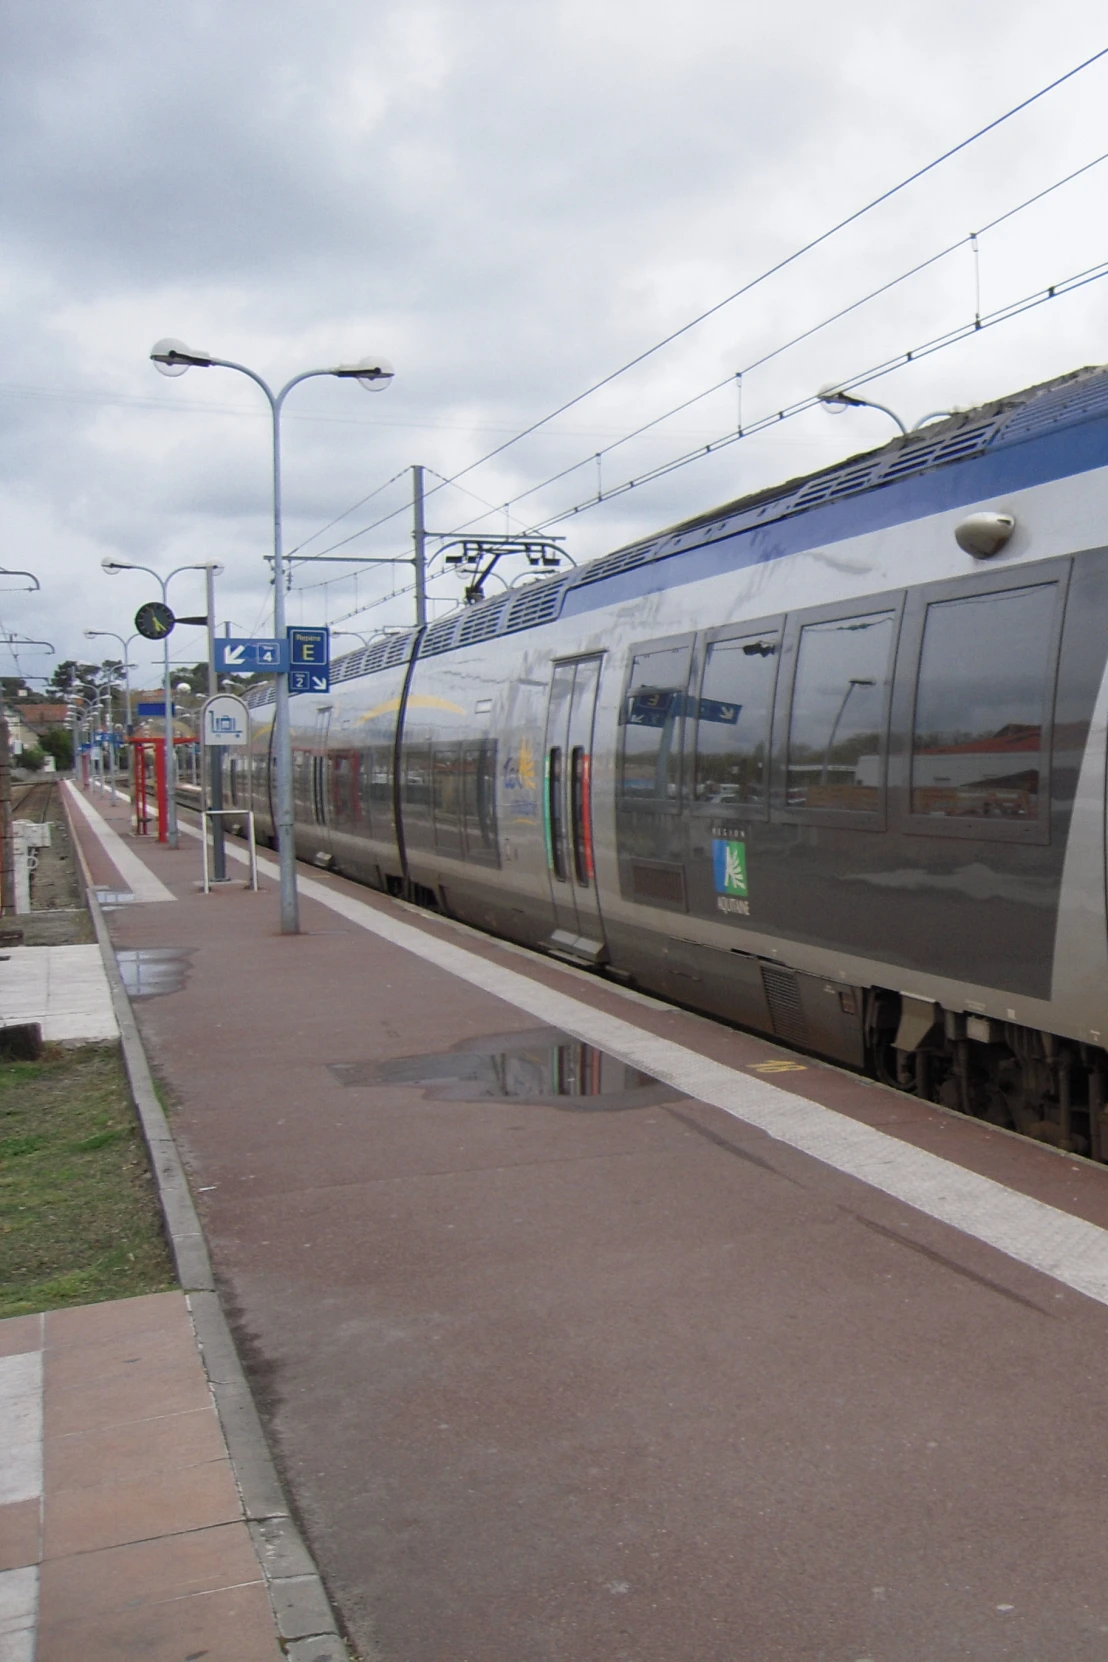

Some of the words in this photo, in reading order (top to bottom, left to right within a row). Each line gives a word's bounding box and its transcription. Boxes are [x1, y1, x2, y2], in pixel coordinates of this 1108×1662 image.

[263, 651, 272, 662] 4
[303, 644, 315, 660] E
[296, 678, 304, 688] 2
